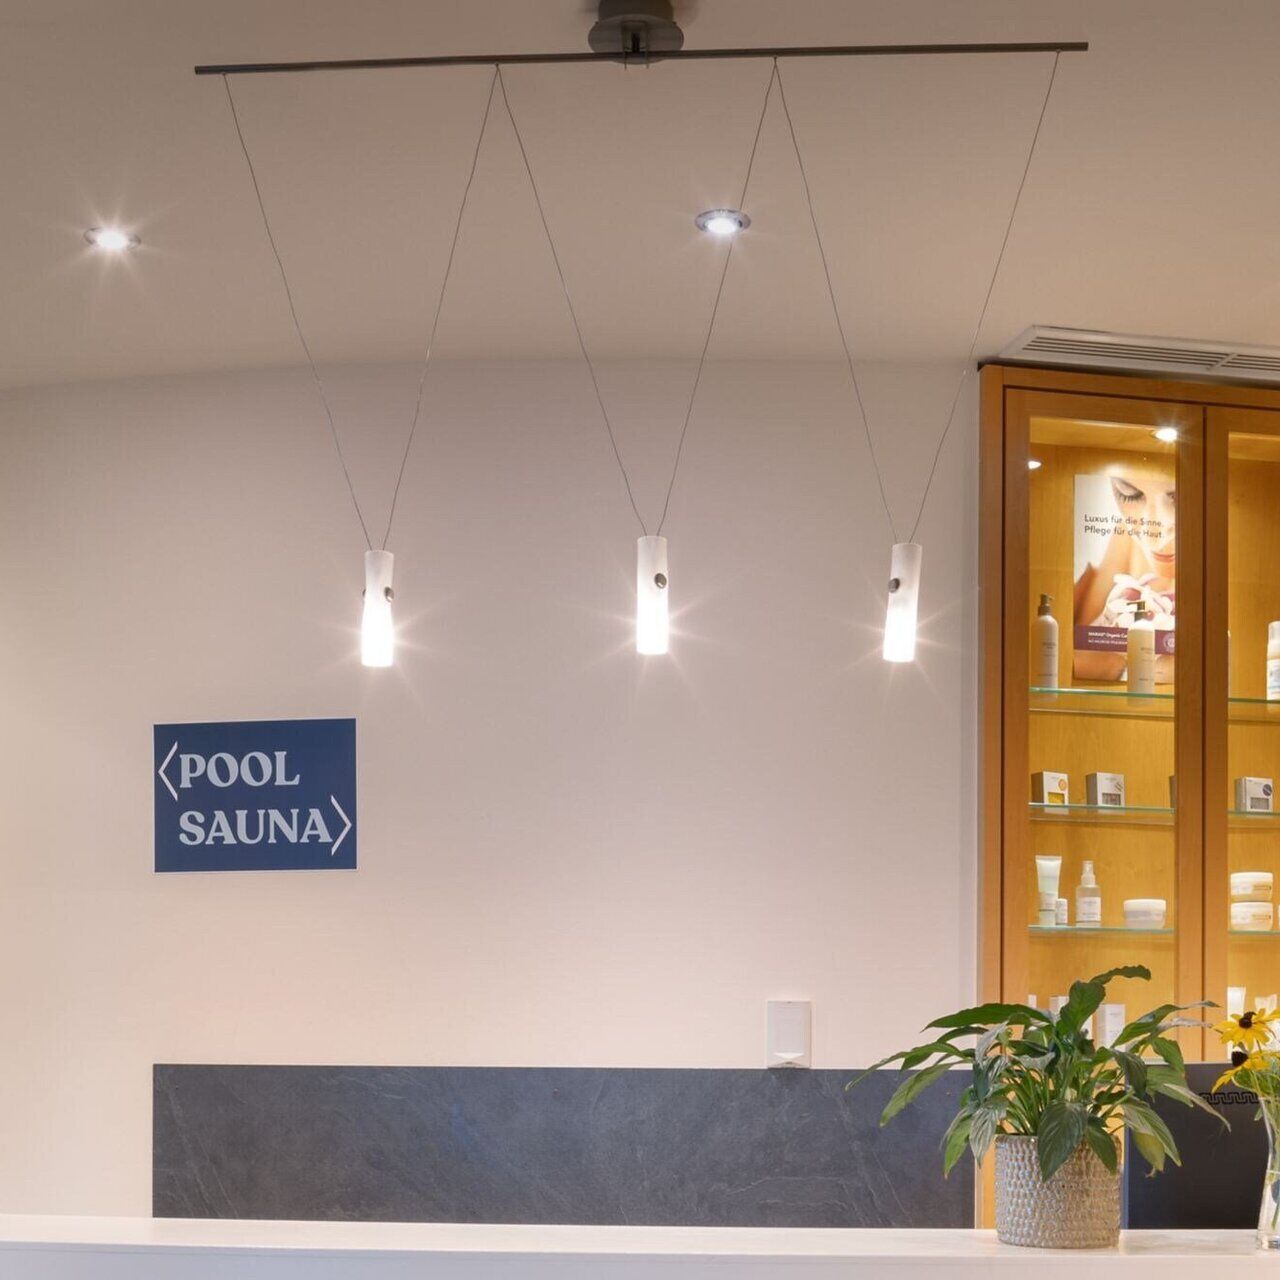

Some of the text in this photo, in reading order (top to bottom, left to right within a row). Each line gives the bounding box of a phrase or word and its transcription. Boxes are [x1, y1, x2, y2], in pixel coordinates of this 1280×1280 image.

[1084, 514, 1108, 523] Luxus
[1111, 514, 1122, 524] für
[1125, 516, 1138, 525] die
[1084, 525, 1111, 536] Pflege
[1114, 526, 1125, 535] für
[179, 750, 301, 789] POOL
[179, 808, 333, 846] SAUNA
